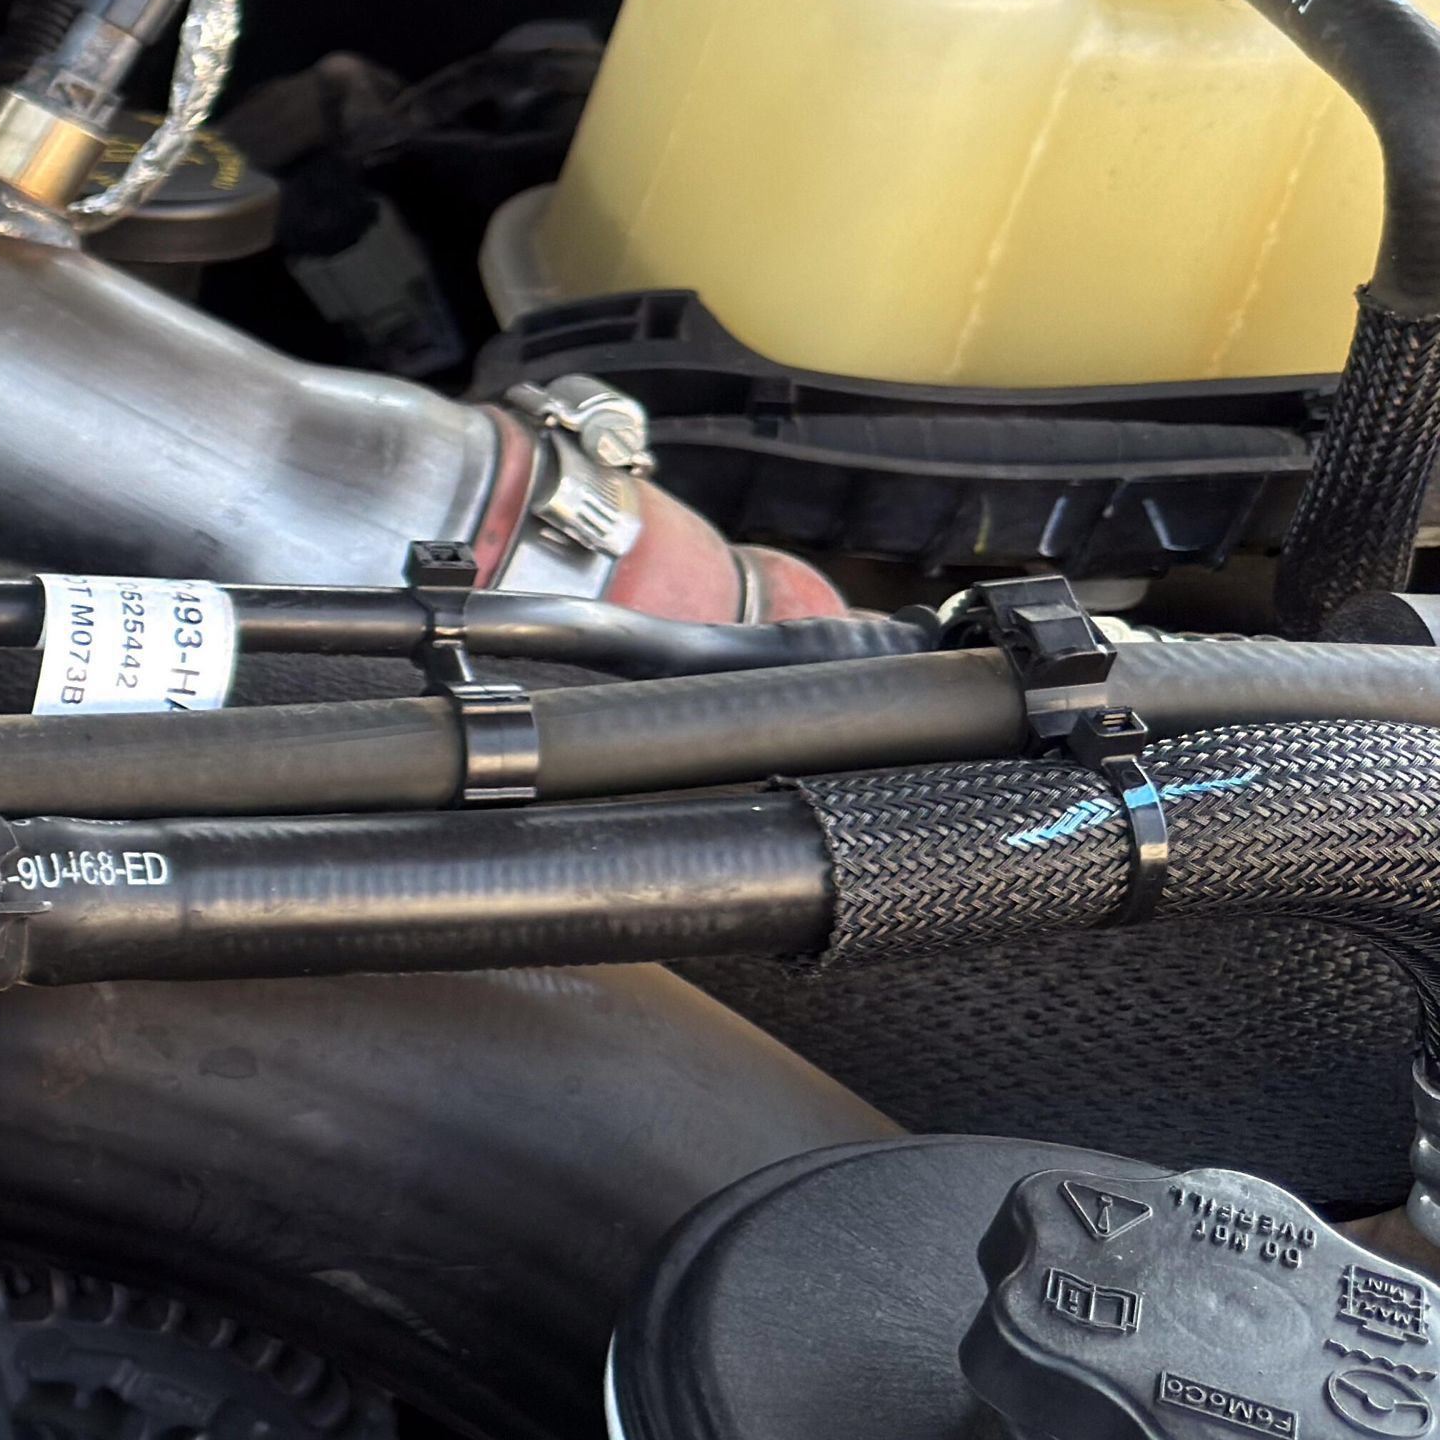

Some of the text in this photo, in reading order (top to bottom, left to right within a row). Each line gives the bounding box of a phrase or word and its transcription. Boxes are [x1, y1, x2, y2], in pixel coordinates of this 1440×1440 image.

[1192, 1220, 1303, 1269] DO NOT
[1166, 1378, 1294, 1436] FoMoCo
